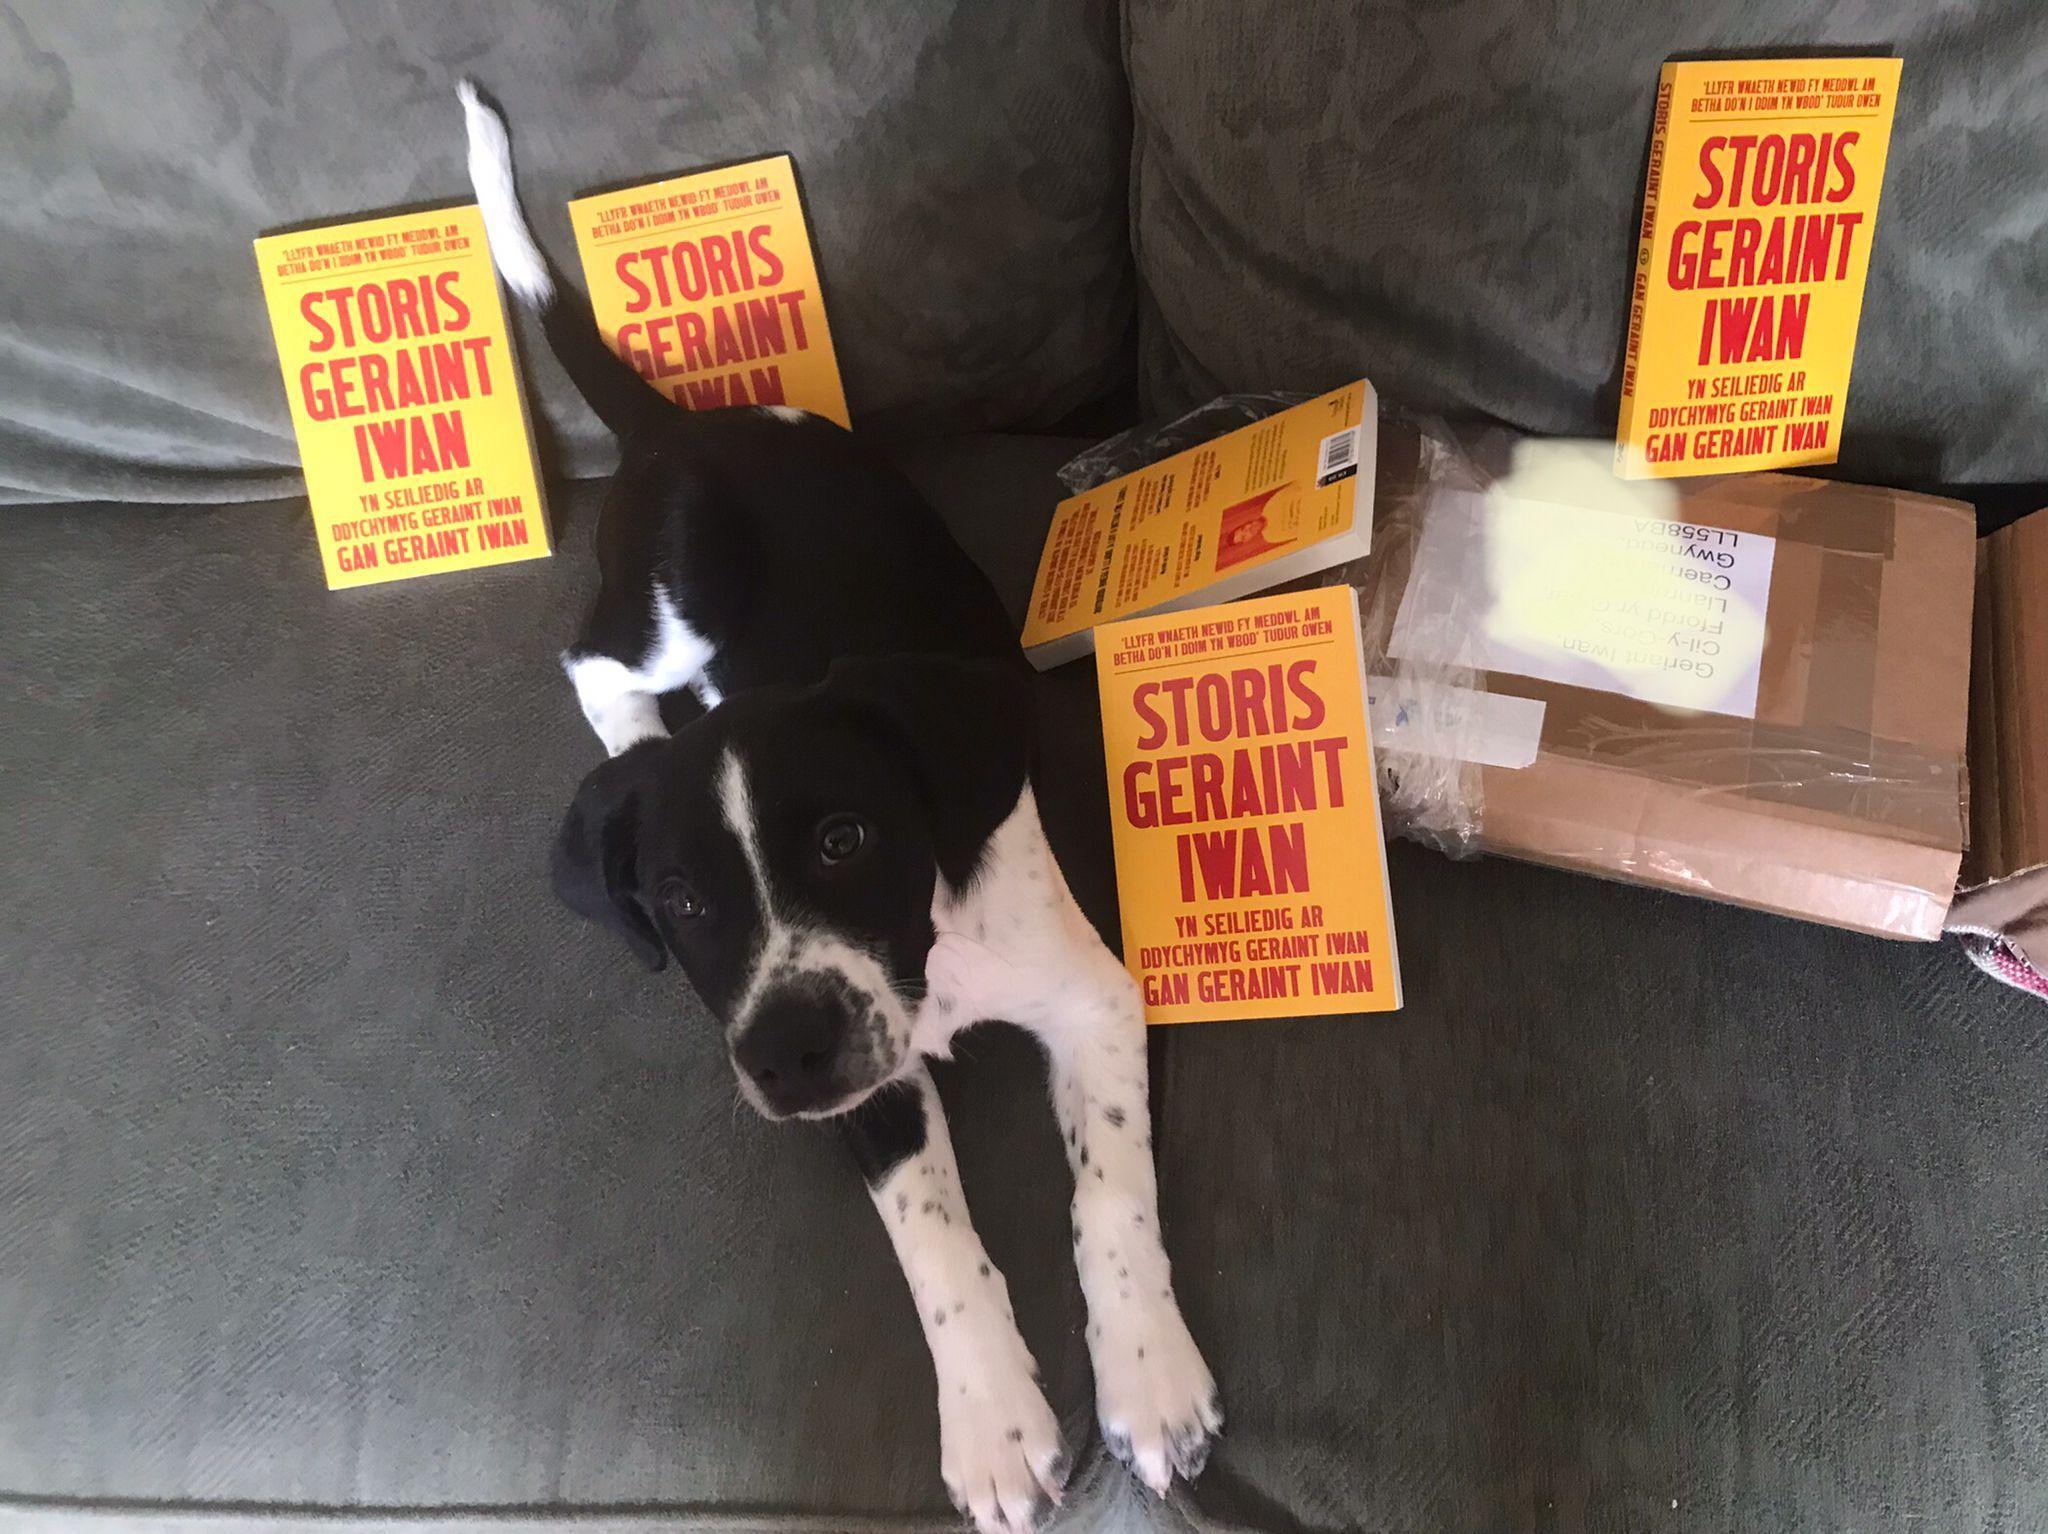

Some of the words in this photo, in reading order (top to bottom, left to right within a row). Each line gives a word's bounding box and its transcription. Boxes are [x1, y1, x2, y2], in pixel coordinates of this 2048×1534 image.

[1656, 82, 1672, 134] STORIS
[1691, 98, 1722, 112] BETHA
[1754, 96, 1778, 110] DDIM
[1781, 96, 1794, 110] YN
[1826, 94, 1854, 108] TUDUR
[1856, 94, 1881, 108] OWEN
[1738, 79, 1774, 94] WNAETH
[1776, 78, 1806, 93] NEWID
[1808, 79, 1820, 92] FY
[1822, 78, 1859, 92] MEDDWL
[1862, 78, 1876, 91] AM
[1648, 140, 1664, 200] GERAINT
[1692, 132, 1860, 210] STORIS
[1642, 206, 1656, 239] IWAN
[615, 224, 784, 313] STORIS
[1666, 212, 1864, 291] GERAINT
[1635, 273, 1647, 300] GAN
[300, 270, 471, 353] STORIS
[616, 290, 808, 381] GERAINT
[1628, 305, 1643, 362] GERAINT
[1698, 293, 1810, 366] IWAN
[300, 336, 492, 422] GERAINT
[1624, 366, 1636, 397] IWAN
[1688, 377, 1706, 400] YN
[1710, 372, 1784, 397] SEILIEDIG
[1787, 371, 1804, 392] AR
[1648, 403, 1736, 428] DDYCHYMYG
[1740, 398, 1798, 422] GERAINT
[1801, 395, 1832, 415] IWAN
[353, 410, 471, 483] IWAN
[1646, 431, 1687, 463] GAN
[1693, 425, 1778, 459] GERAINT
[1782, 421, 1829, 452] IWAN
[332, 511, 419, 542] DDYCHYMYG
[422, 502, 482, 529] GERAINT
[488, 495, 522, 518] IWAN
[360, 489, 380, 513] YN
[384, 480, 459, 510] SEILIEDIG
[465, 478, 484, 498] AR
[337, 544, 378, 572] GAN
[384, 527, 470, 566] GERAINT
[478, 518, 528, 550] IWAN
[1114, 650, 1146, 666] BETHA
[1148, 645, 1172, 661] DO'N
[1182, 639, 1207, 656] DDIM
[1210, 637, 1224, 651] YN
[1264, 626, 1298, 643] TUDUR
[1302, 620, 1332, 637] OWEN
[1158, 626, 1198, 645] WNAETH
[1202, 620, 1234, 637] NEWID
[1237, 617, 1250, 632] FY
[1254, 610, 1300, 628] MEDDWL
[1304, 606, 1320, 621] AM
[1132, 659, 1326, 751] STORIS
[1122, 737, 1348, 830] GERAINT
[1176, 822, 1310, 903] IWAN
[1174, 915, 1196, 938] YN
[1204, 908, 1294, 936] SEILIEDIG
[1301, 905, 1324, 928] AR
[1140, 941, 1241, 970] DDYCHYMYG
[1246, 935, 1319, 961] GERAINT
[1326, 930, 1369, 955] IWAN
[1144, 973, 1190, 1006] GAN
[1196, 965, 1302, 1004] GERAINT
[1311, 960, 1374, 995] IWAN
